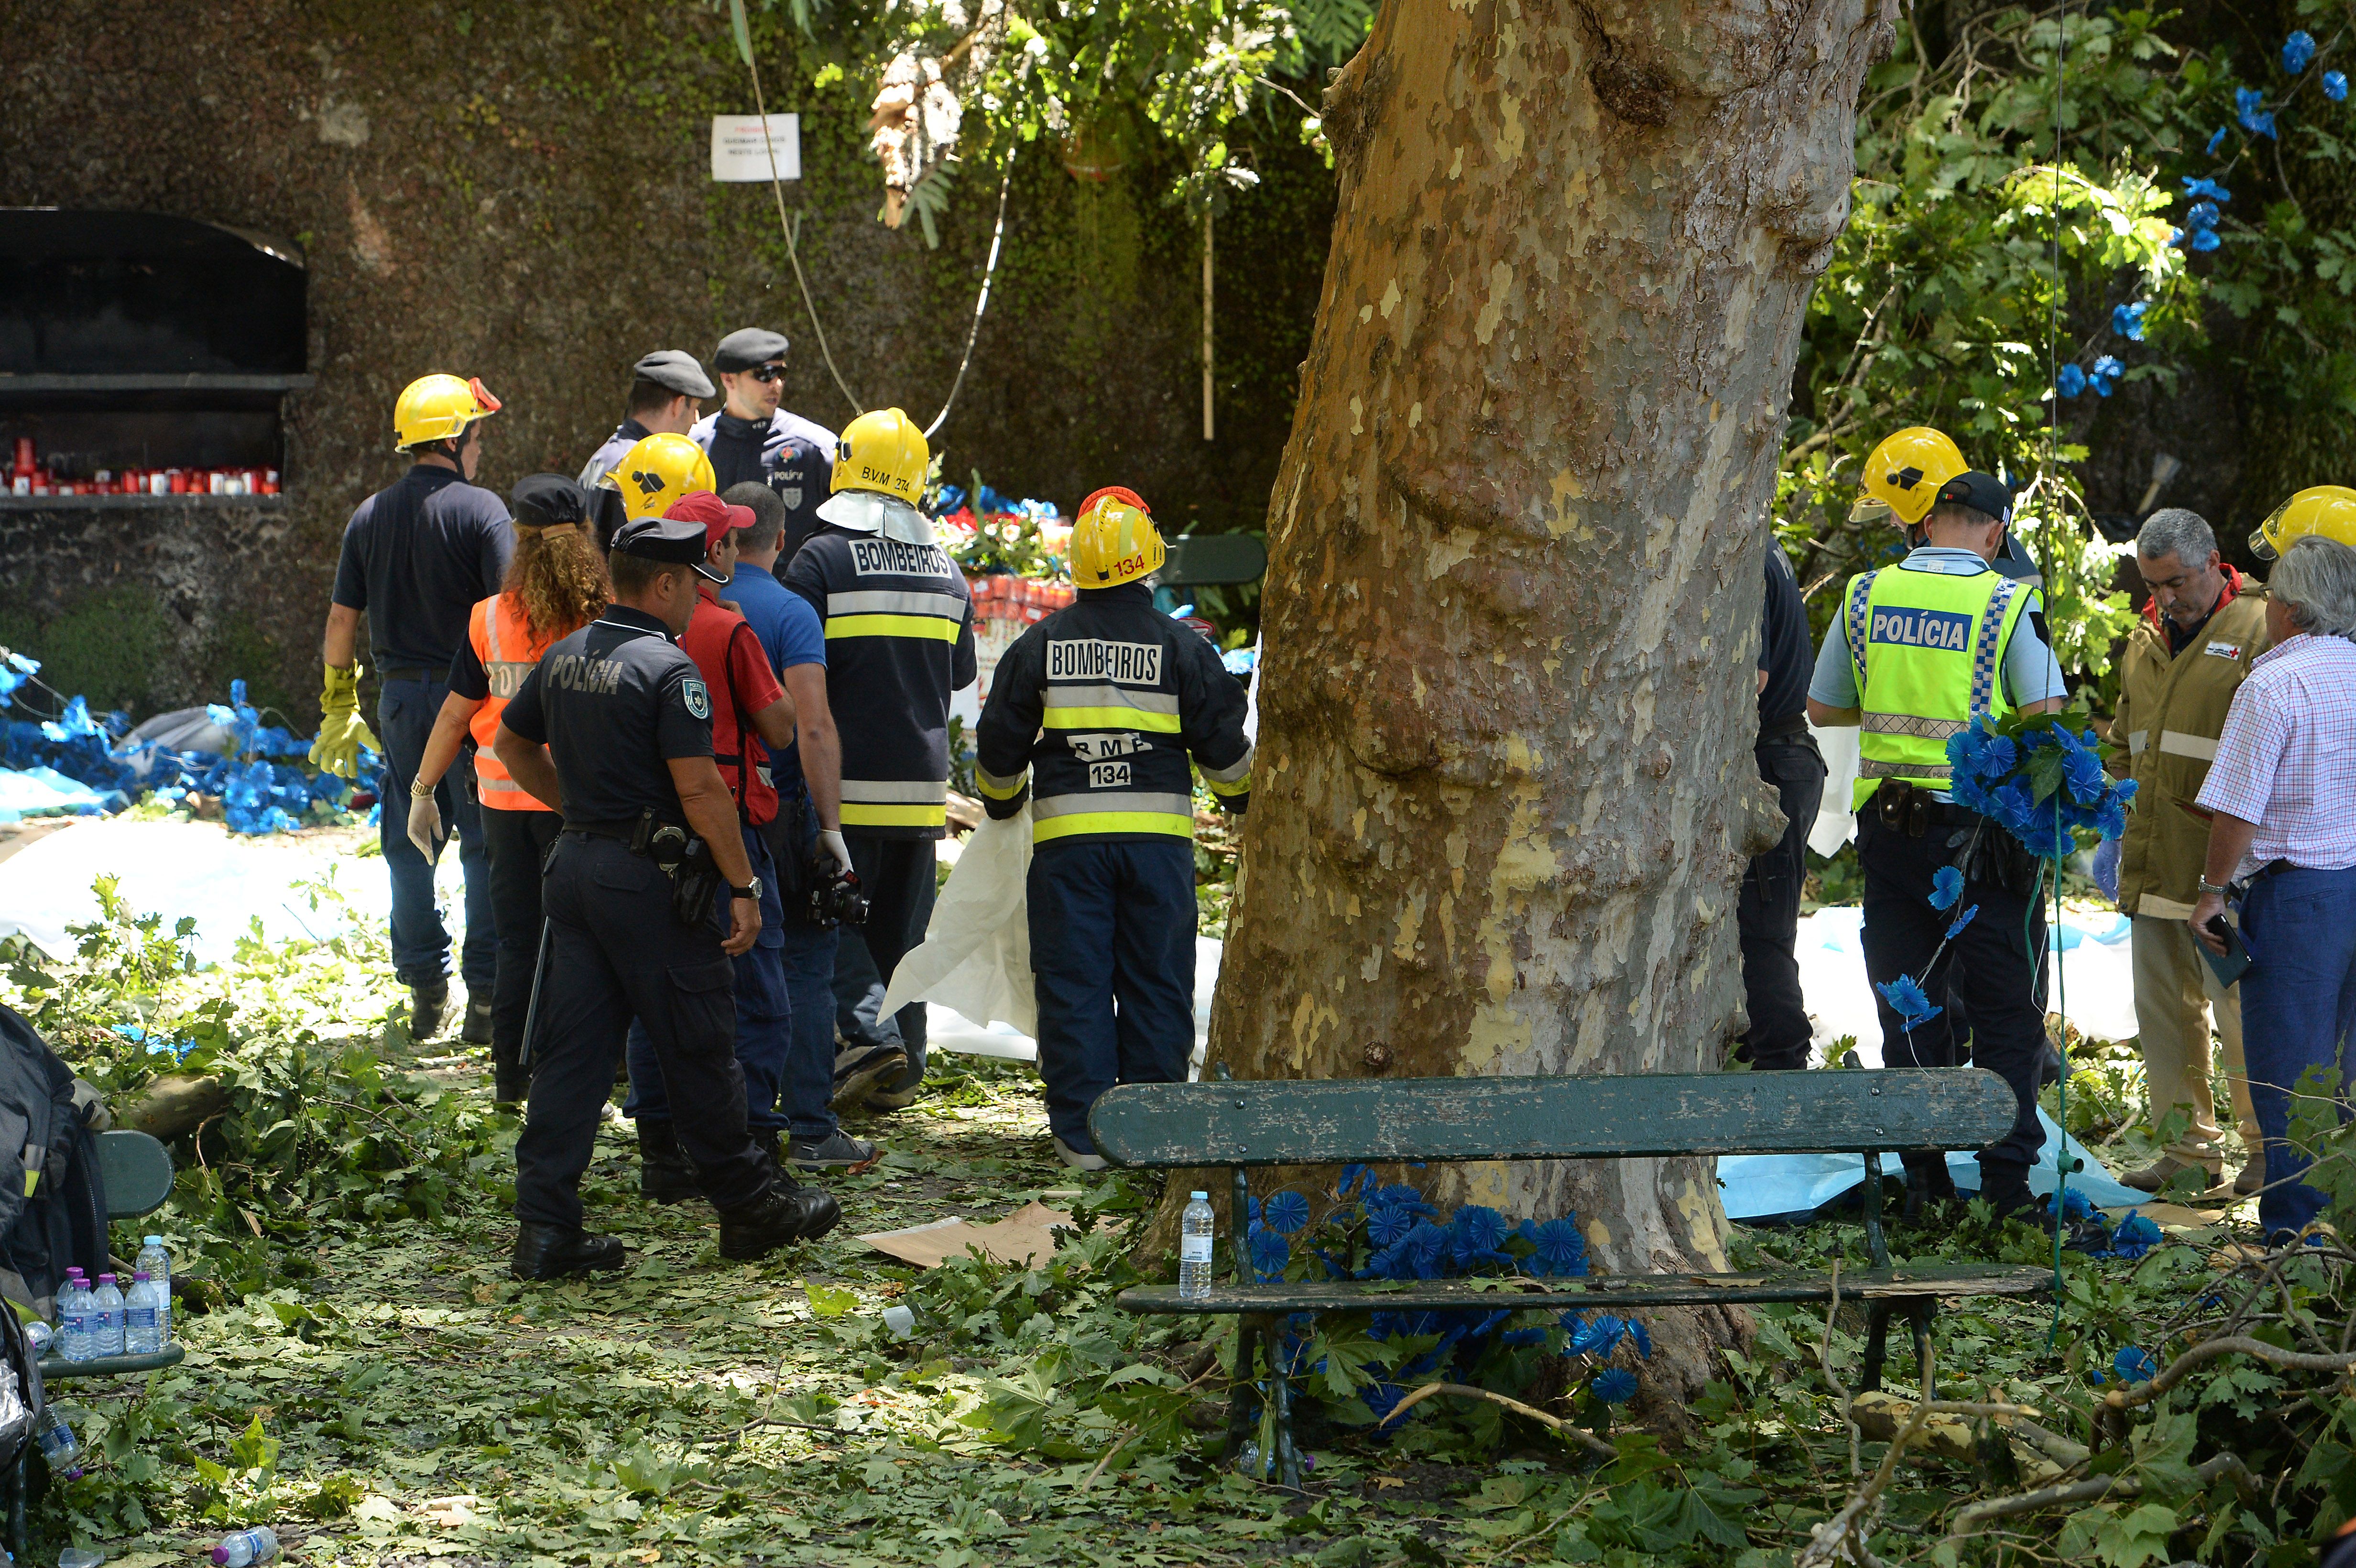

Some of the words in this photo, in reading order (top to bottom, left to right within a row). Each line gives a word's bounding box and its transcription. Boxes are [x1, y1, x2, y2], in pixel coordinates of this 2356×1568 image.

[894, 478, 910, 493] 274
[854, 542, 948, 574] BOMBEIROS
[1113, 554, 1145, 577] 134
[1871, 610, 1964, 650] POLÍCIA
[548, 649, 623, 695] POLÍCIA
[1052, 642, 1156, 681] BOMBEIROS
[1091, 765, 1129, 784] 134
